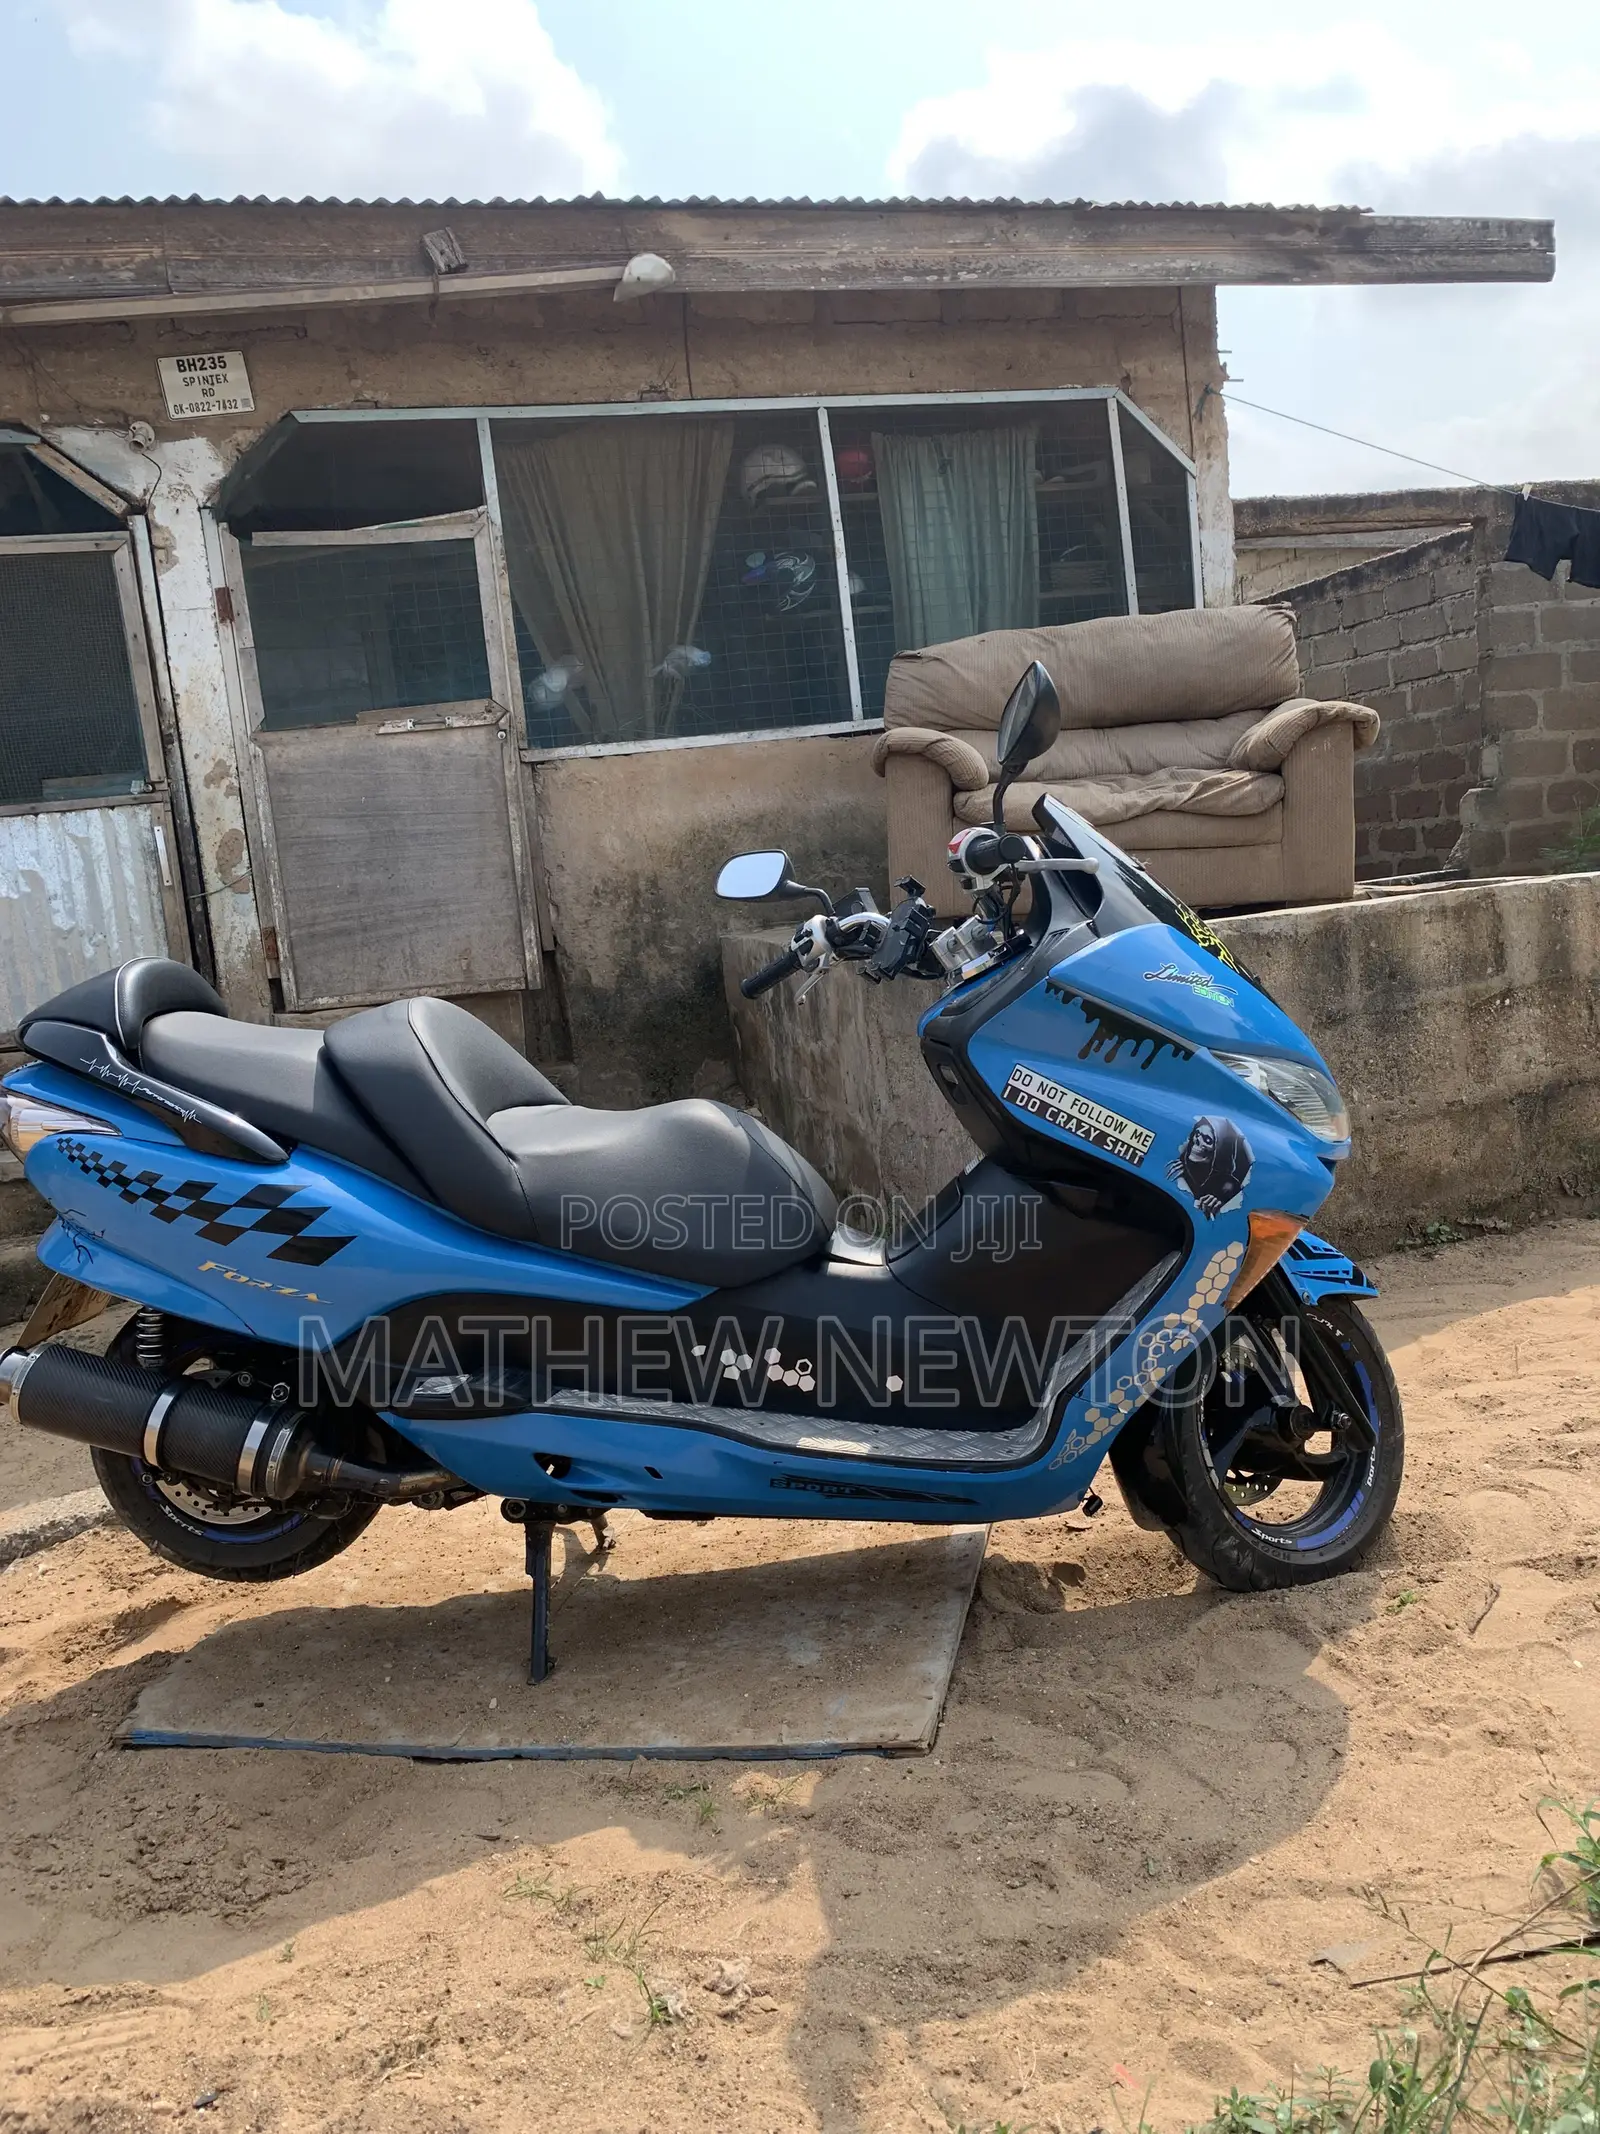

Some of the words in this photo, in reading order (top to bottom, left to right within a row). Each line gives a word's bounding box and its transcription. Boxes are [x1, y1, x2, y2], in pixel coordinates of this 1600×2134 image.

[176, 356, 227, 373] BH235
[182, 374, 229, 387] SPINTEX
[201, 388, 216, 398] RD
[173, 399, 239, 415] GK-0822-7432
[1144, 963, 1237, 995] Limited
[1011, 1068, 1033, 1087] DO
[1036, 1081, 1068, 1104] NOT
[1069, 1097, 1128, 1135] FOLLOW
[1129, 1128, 1152, 1148] ME
[1003, 1085, 1011, 1099] I
[1015, 1092, 1040, 1113] DO
[1045, 1106, 1101, 1142] CRAZY
[1103, 1136, 1145, 1165] SHIT
[772, 1478, 856, 1495] SPORT
[1250, 1527, 1293, 1545] Sports
